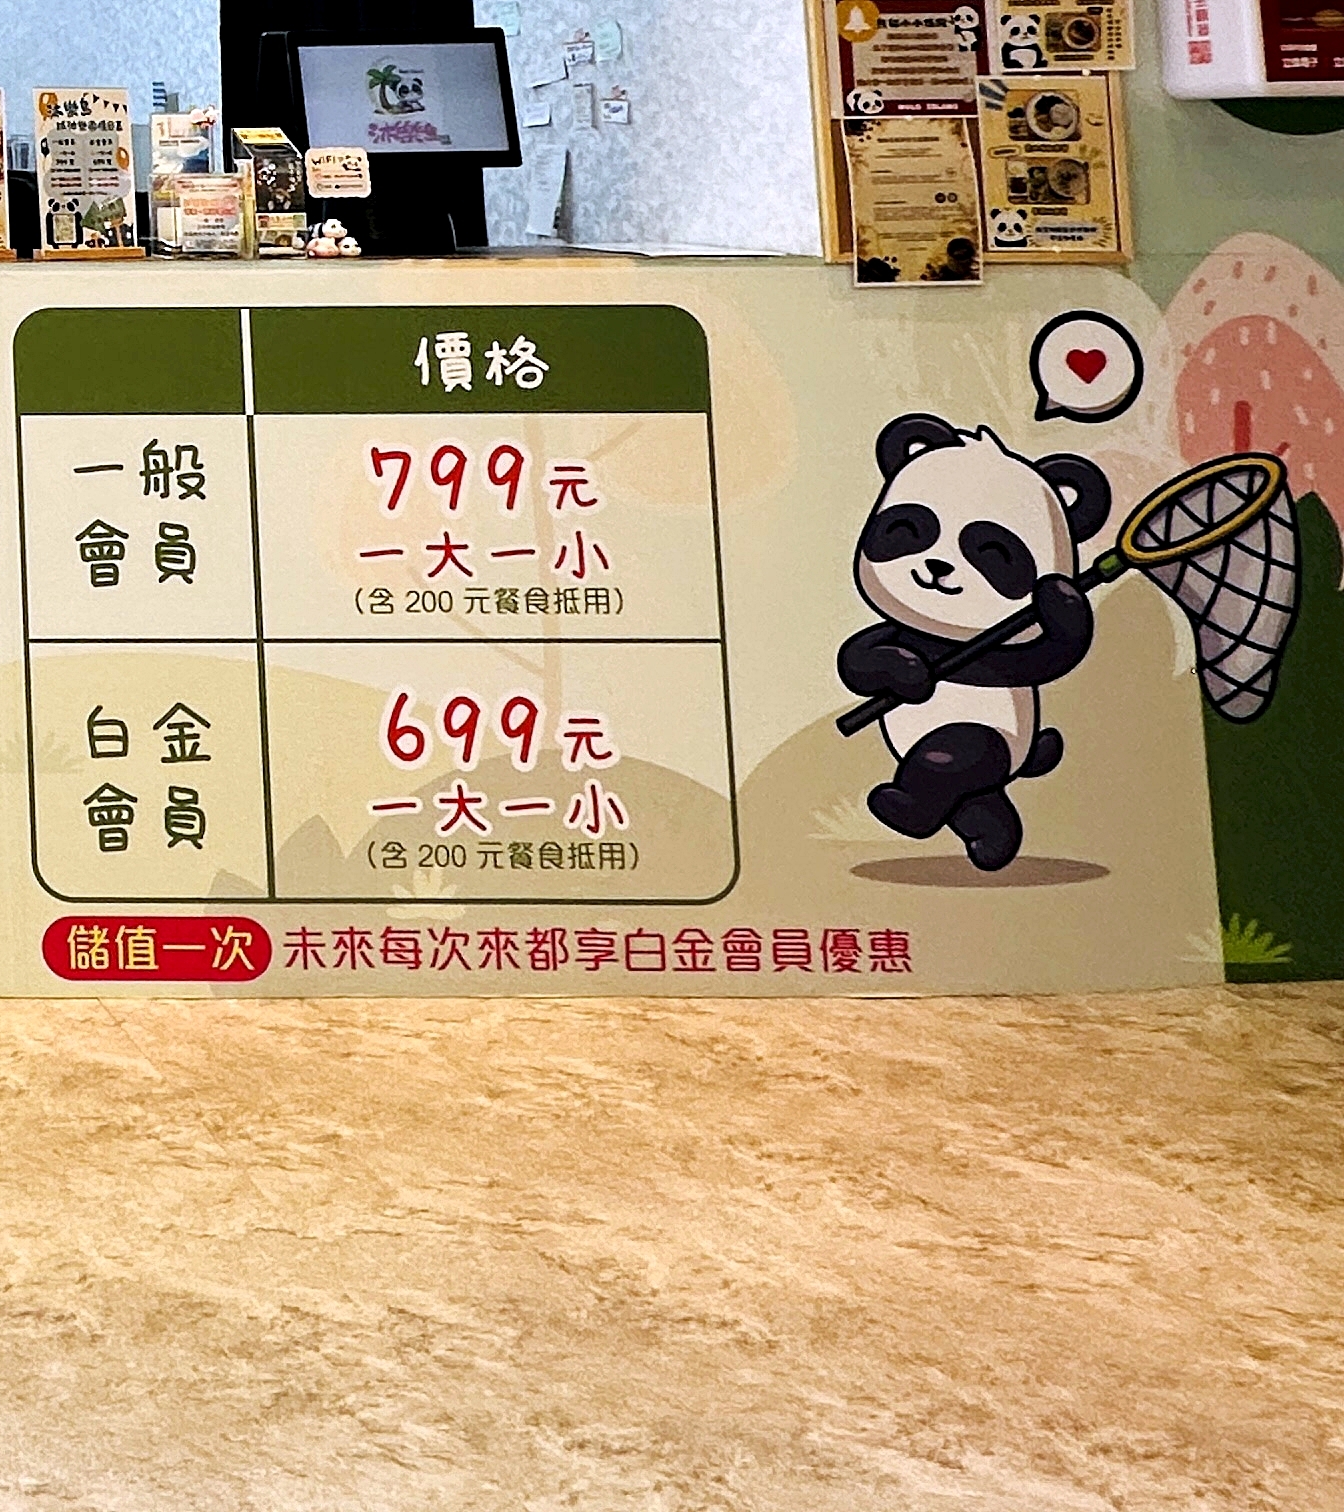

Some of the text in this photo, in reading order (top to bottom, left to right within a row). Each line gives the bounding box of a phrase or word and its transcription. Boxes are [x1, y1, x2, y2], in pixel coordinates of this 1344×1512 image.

[414, 333, 550, 392] 價格
[74, 440, 207, 501] 一般
[76, 518, 609, 587] 會員 一大一小
[405, 589, 454, 615] 200
[87, 702, 212, 766] 白金
[84, 784, 625, 852] 會員 一大一小
[418, 843, 466, 870] 200
[68, 926, 912, 974] 儲值一次 未來每次來都享白金會員優惠
